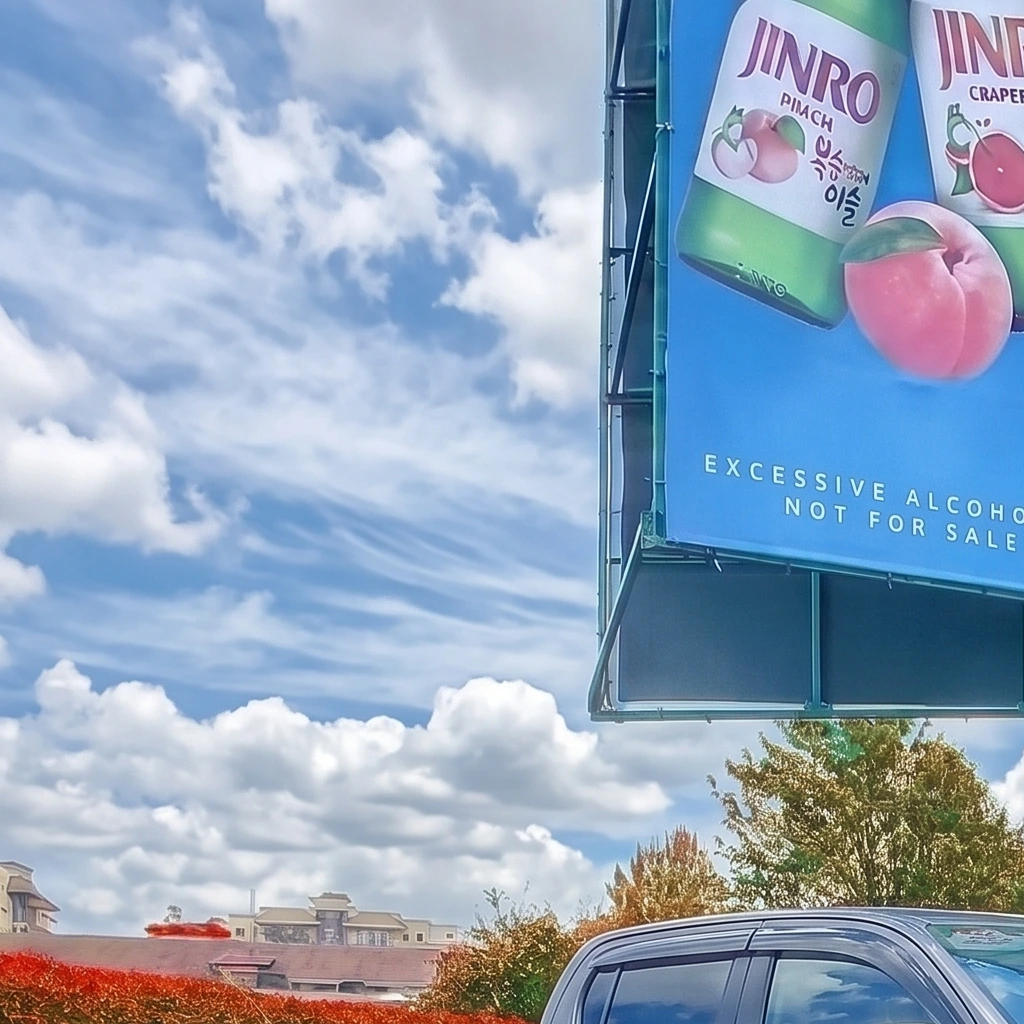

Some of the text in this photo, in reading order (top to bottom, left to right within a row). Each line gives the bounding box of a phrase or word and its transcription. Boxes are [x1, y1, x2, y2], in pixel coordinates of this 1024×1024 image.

[737, 17, 881, 125] JINRO
[704, 453, 885, 501] EXCESSIVE
[784, 496, 847, 524] NOT
[869, 510, 925, 537] FOR
[946, 523, 1017, 551] SALE
